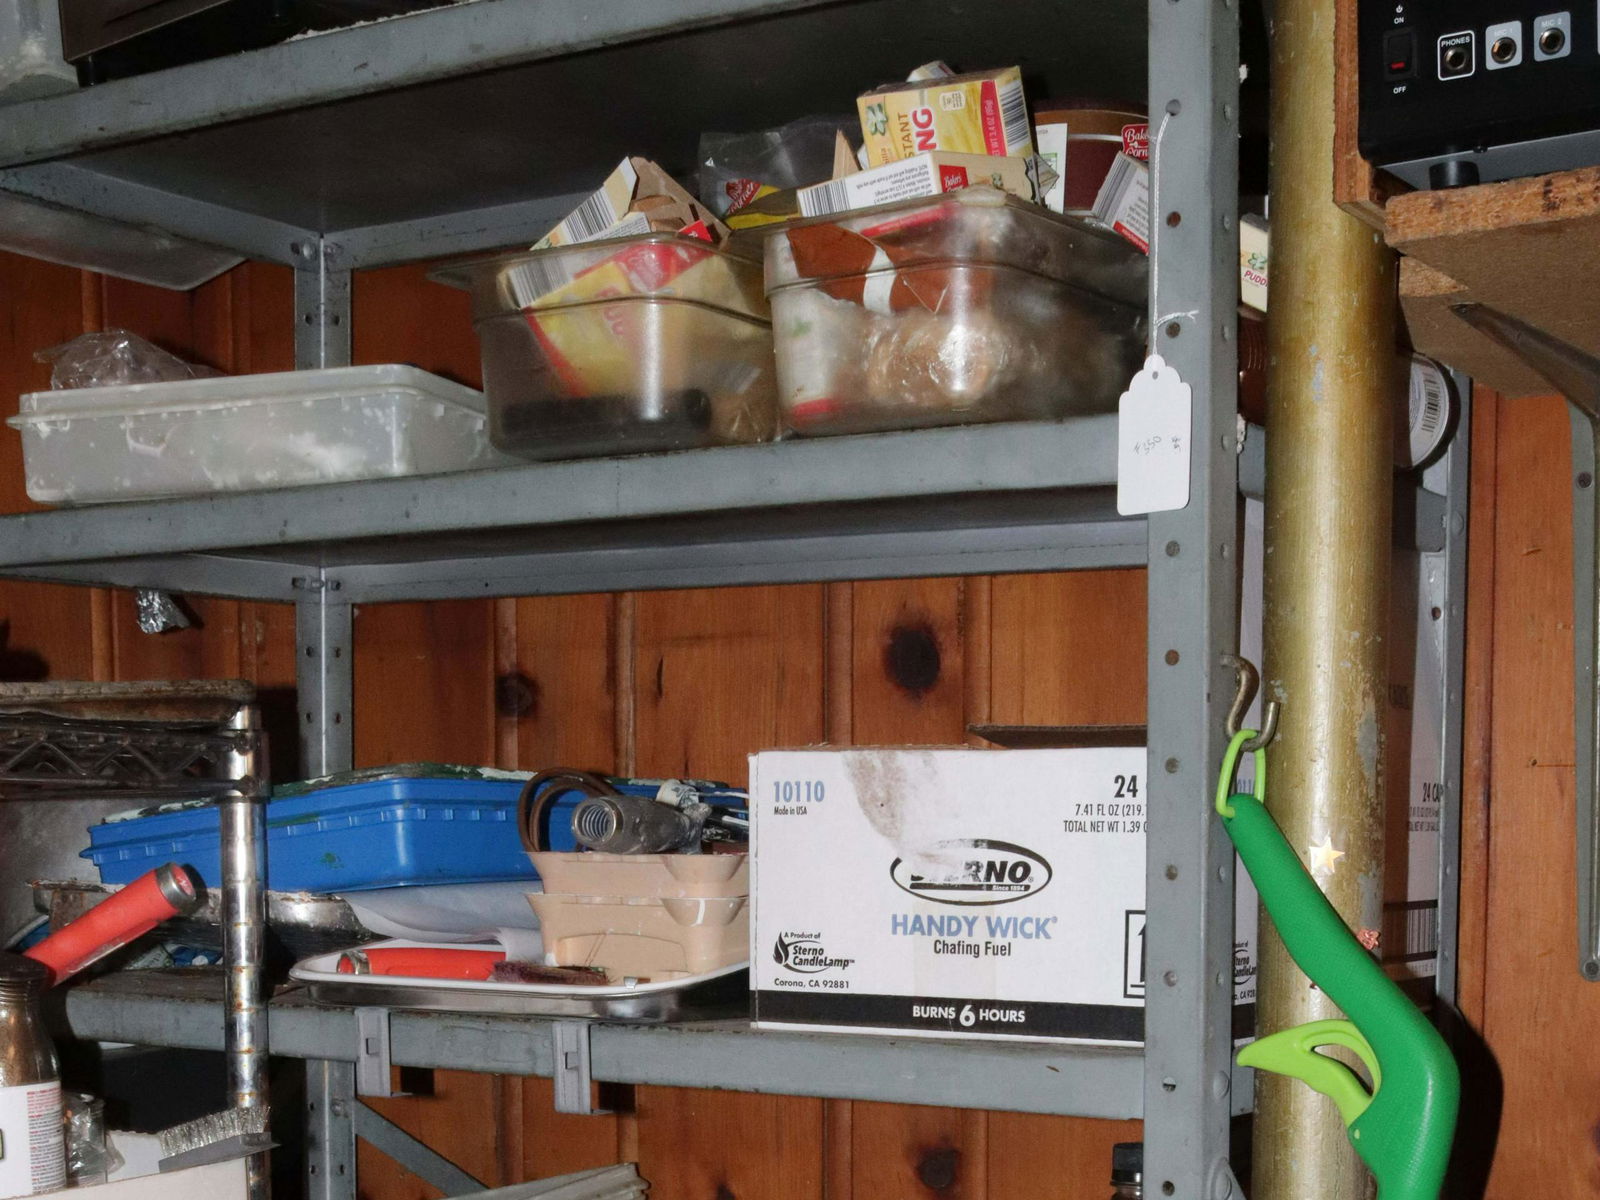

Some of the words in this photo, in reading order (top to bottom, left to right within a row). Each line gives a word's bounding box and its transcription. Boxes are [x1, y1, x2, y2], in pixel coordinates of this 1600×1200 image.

[1393, 16, 1405, 24] ON
[1440, 36, 1470, 48] PHONES
[1393, 85, 1407, 94] OFF
[912, 108, 937, 150] NG
[897, 113, 914, 159] STANT
[774, 781, 825, 803] 10110
[1114, 775, 1138, 798] 24
[774, 806, 788, 815] Made
[790, 806, 795, 815] in
[796, 806, 807, 815] USA
[1075, 804, 1093, 816] 7.41
[1097, 804, 1105, 816] FL
[1108, 804, 1119, 816] OZ
[1063, 820, 1088, 832] TOTAL
[1090, 820, 1105, 832] NET
[1107, 820, 1119, 832] WT
[1122, 821, 1141, 833] 1.39
[891, 914, 979, 937] HANDY
[792, 945, 824, 956] Sterno
[934, 940, 980, 958] Chafing
[984, 941, 1011, 956] Fuel
[774, 978, 806, 988] Corona,
[808, 980, 820, 988] CA
[822, 980, 849, 989] 92881
[913, 1005, 956, 1019] BURNS
[959, 1004, 976, 1027] 6
[979, 1008, 1026, 1023] HOURS
